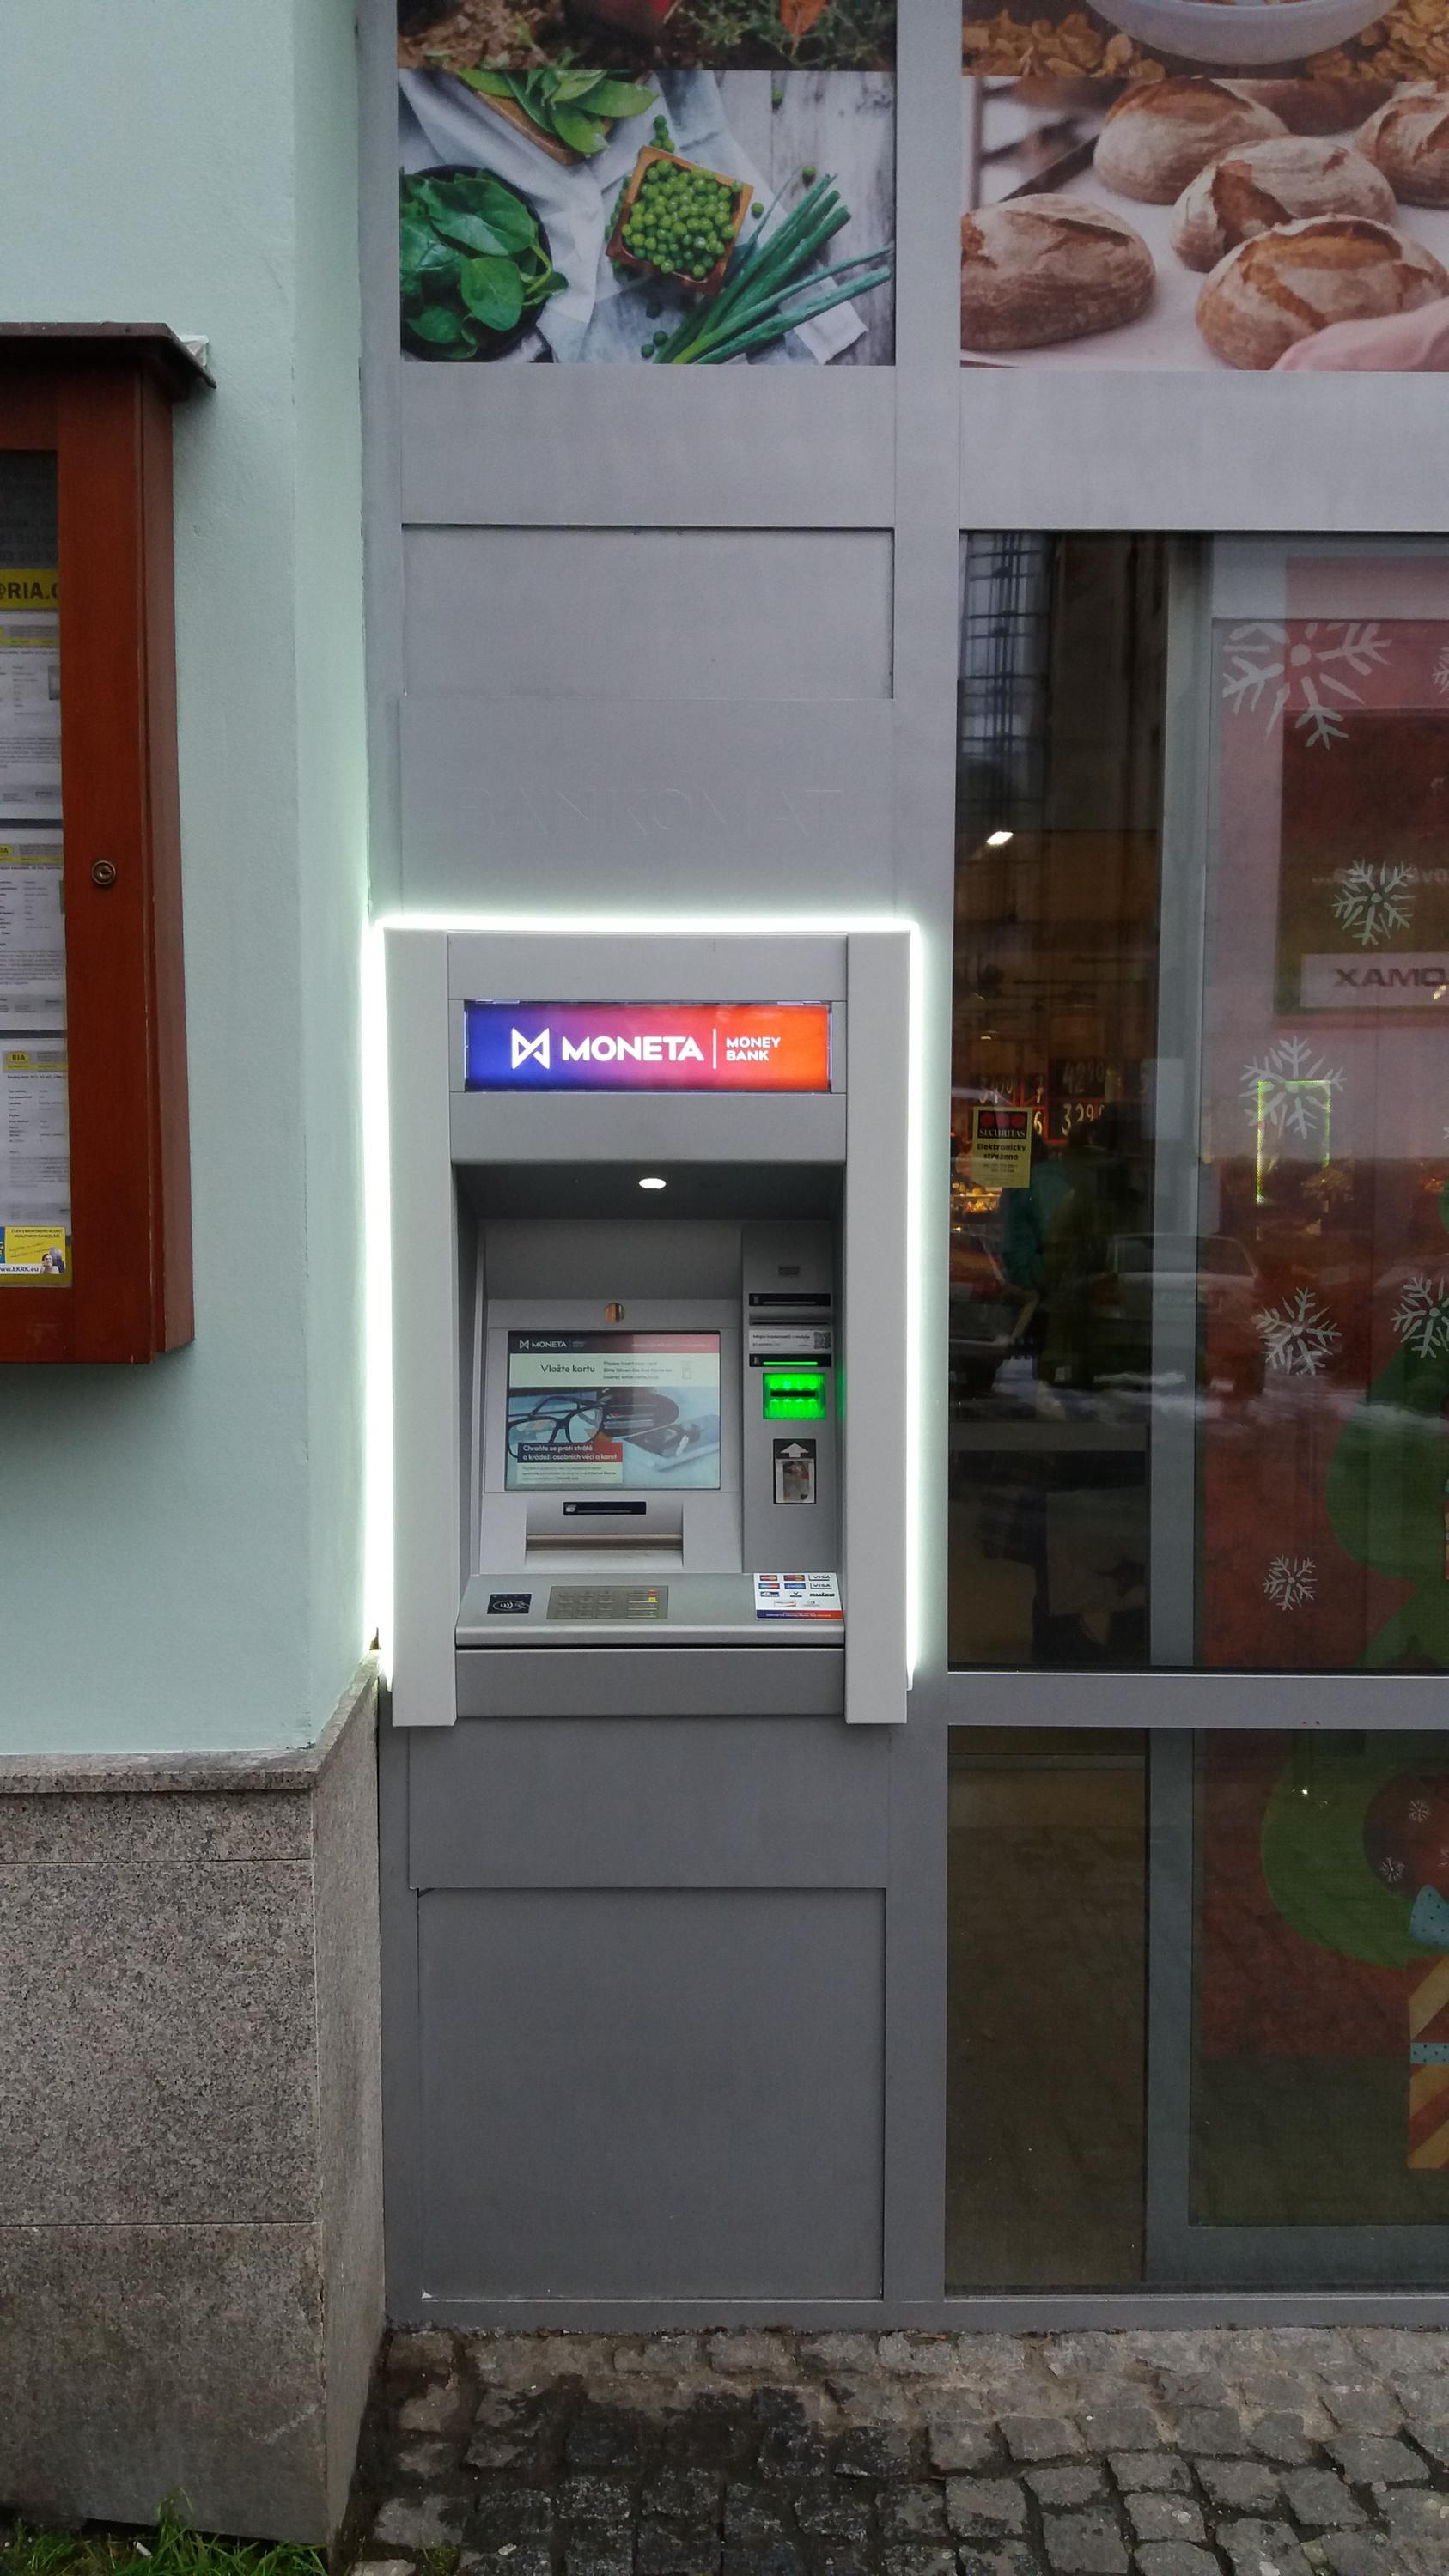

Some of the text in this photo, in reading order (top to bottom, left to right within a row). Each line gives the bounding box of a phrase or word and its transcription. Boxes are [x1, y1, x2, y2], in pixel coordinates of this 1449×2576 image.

[455, 787, 843, 837] BANKOMAT
[726, 1036, 782, 1048] MONEY
[562, 1036, 705, 1062] MONETA
[726, 1049, 770, 1062] BANK
[979, 1127, 1026, 1138] SECURITAS
[977, 1143, 1026, 1152] Elektronicky
[540, 1364, 595, 1374] Vložte kartu
[557, 1444, 574, 1453] proti
